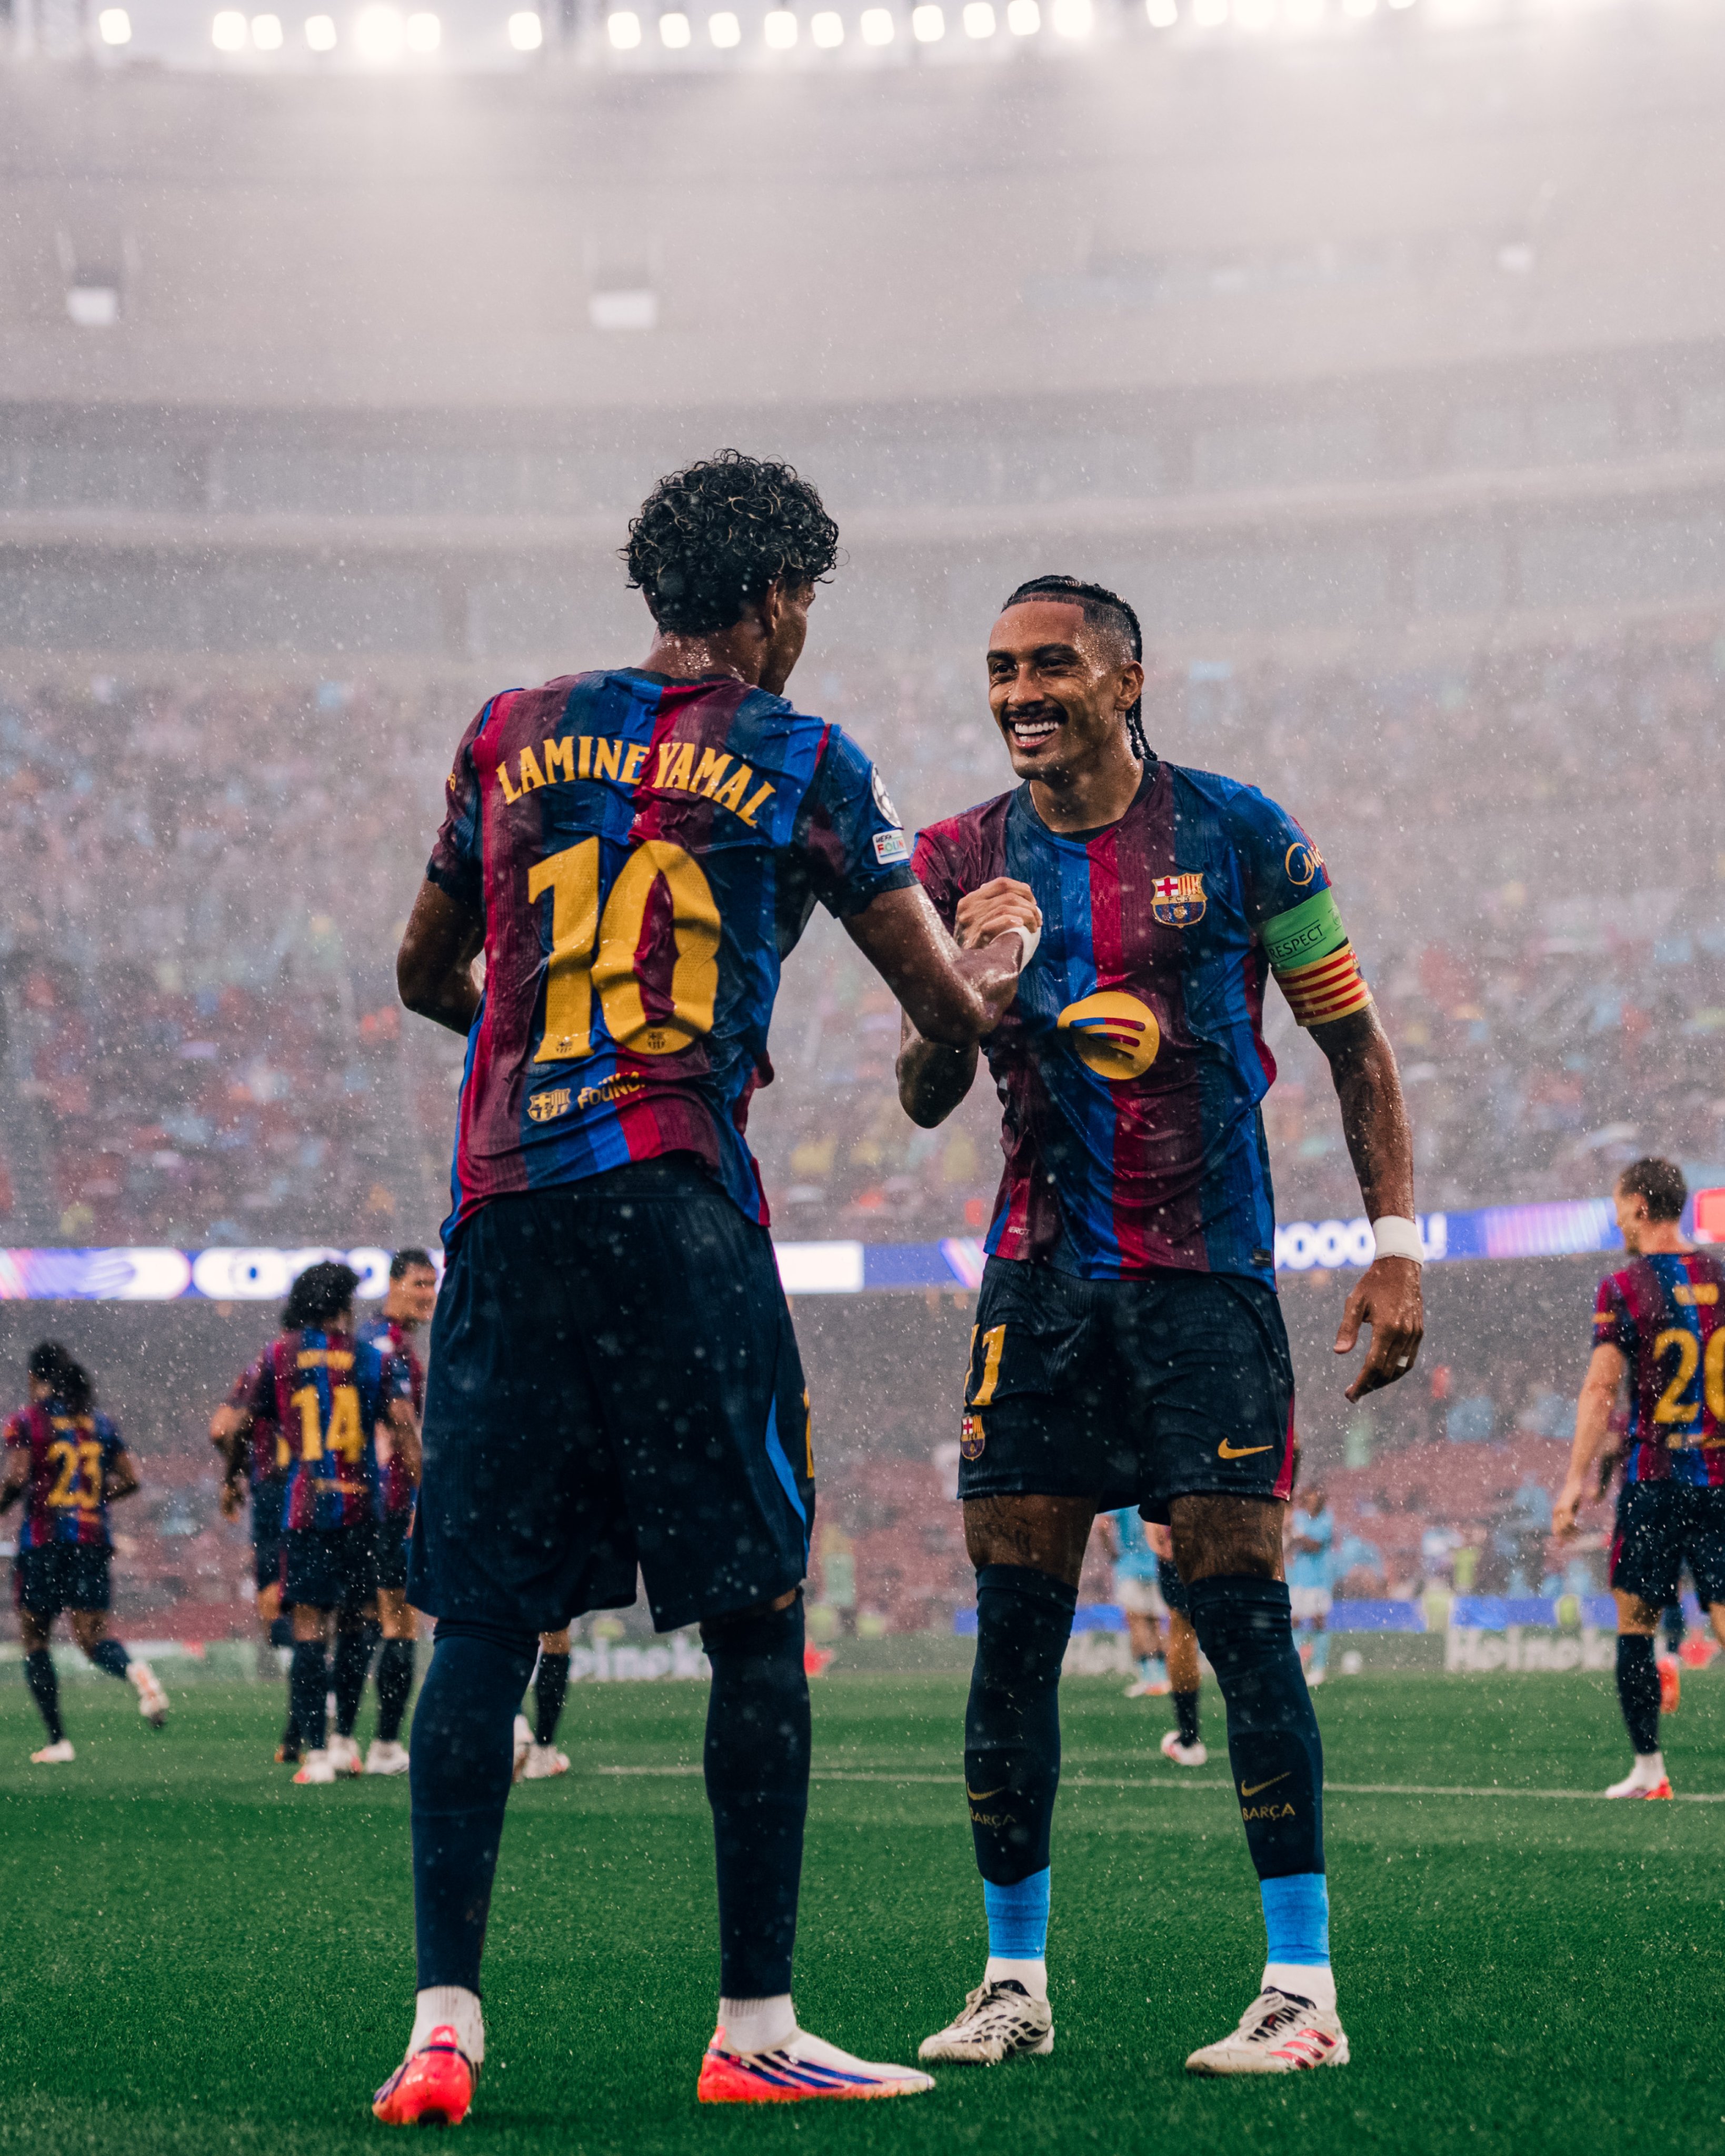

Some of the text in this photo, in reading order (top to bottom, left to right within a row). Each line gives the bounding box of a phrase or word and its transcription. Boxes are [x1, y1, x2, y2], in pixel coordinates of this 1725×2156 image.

[495, 736, 777, 827] LAMINE YAMAL
[528, 835, 721, 1063] 10
[1269, 924, 1323, 959] RESPECT
[291, 1384, 364, 1463] 14
[47, 1441, 103, 1509] 23
[1445, 1626, 1616, 1672] Heinek
[1242, 1803, 1295, 1821] BARÇA
